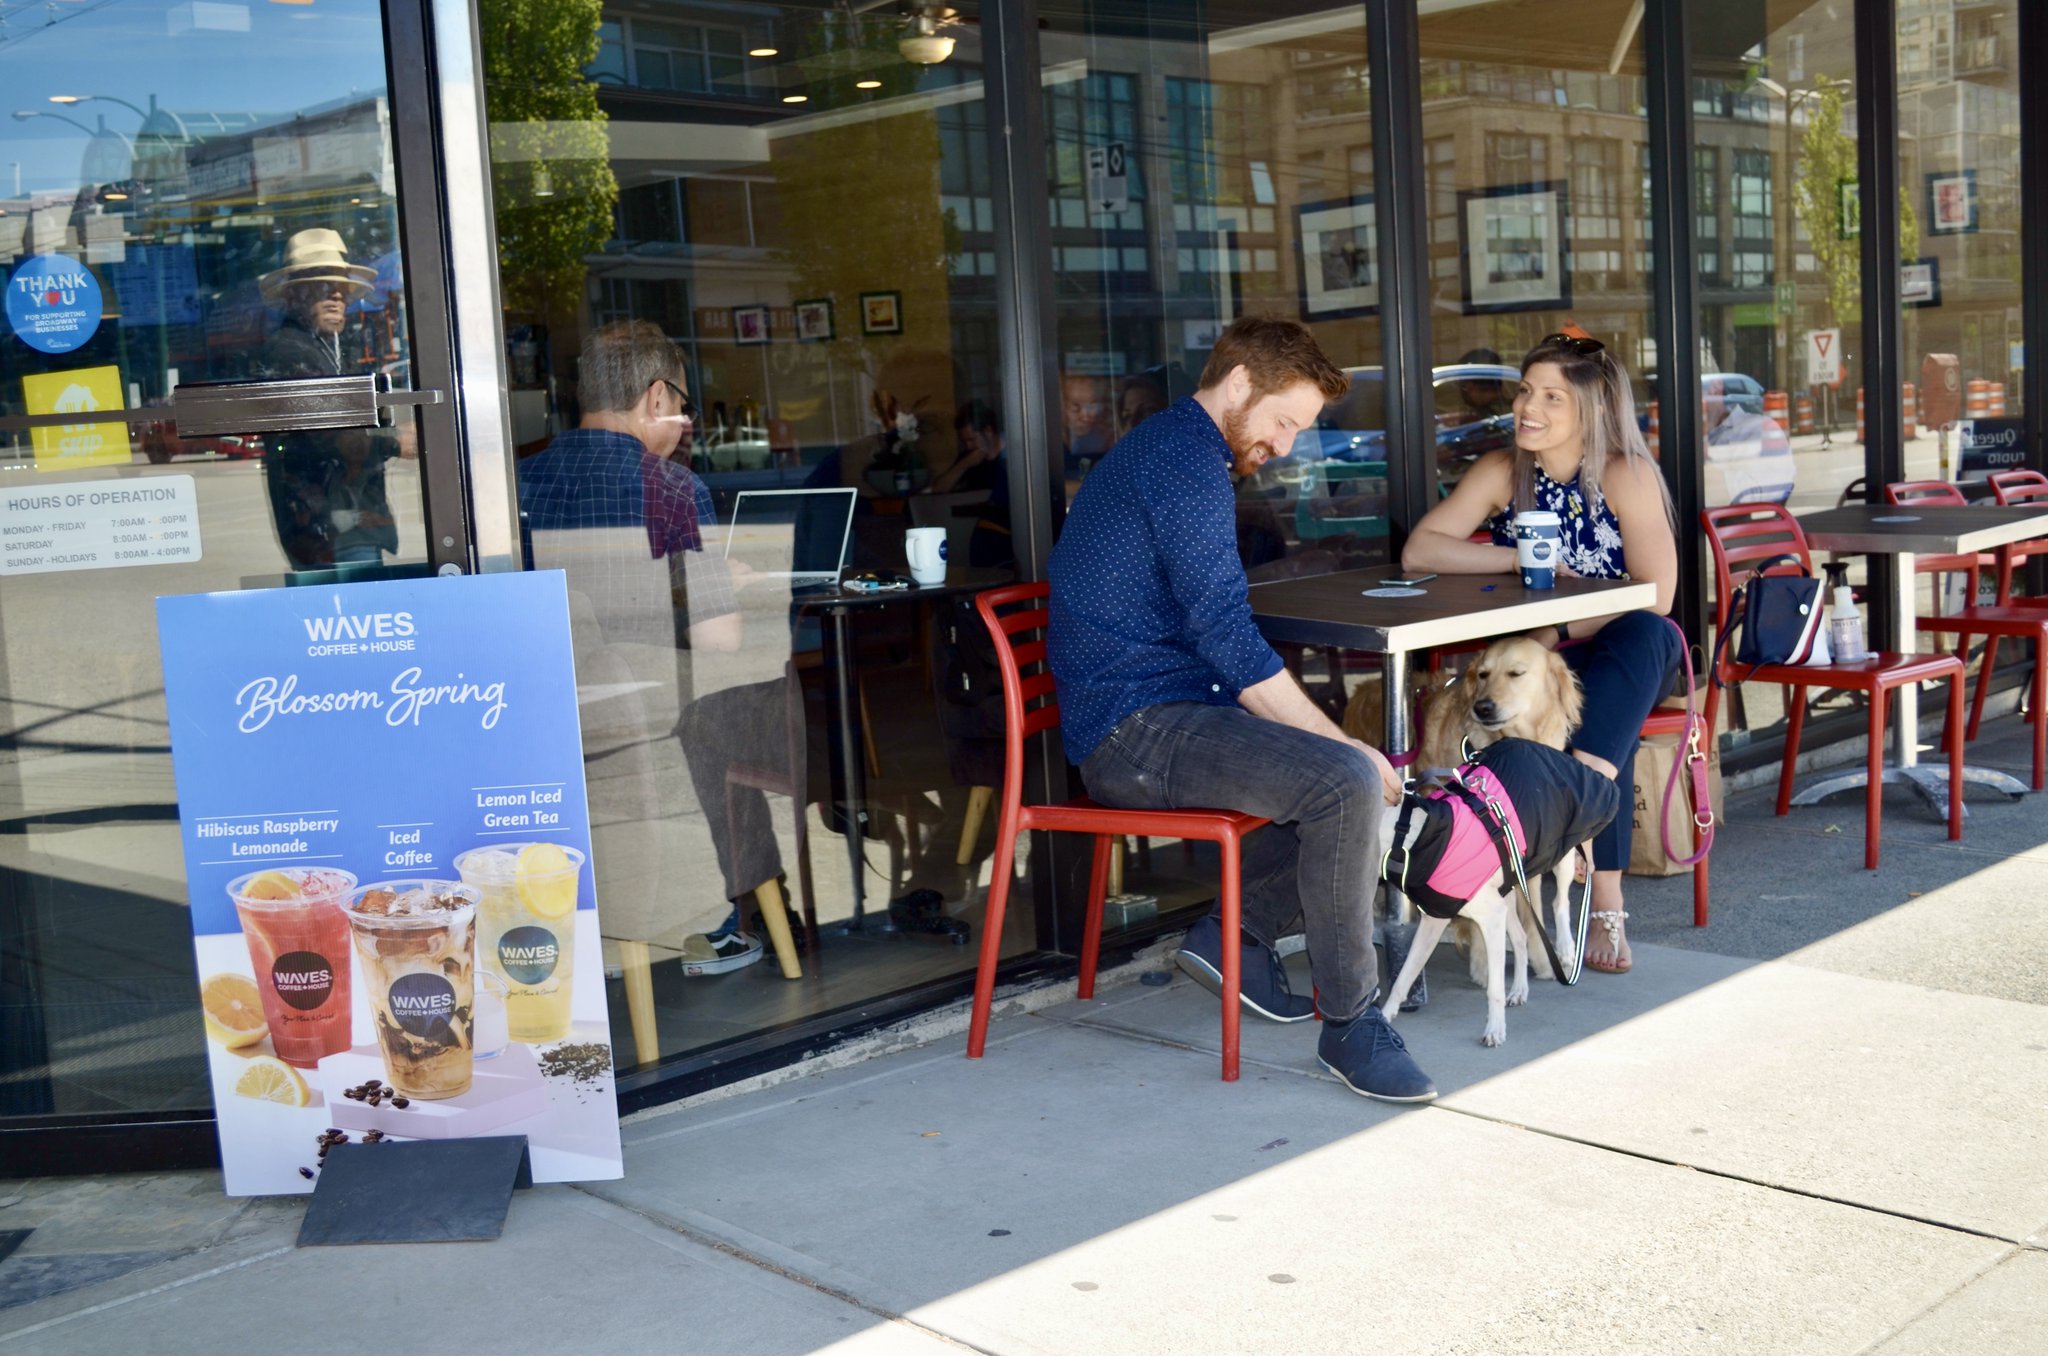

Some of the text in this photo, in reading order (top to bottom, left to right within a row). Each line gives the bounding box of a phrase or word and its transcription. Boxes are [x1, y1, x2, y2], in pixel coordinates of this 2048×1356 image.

[16, 272, 88, 293] THANK
[24, 310, 87, 321] FOR SUPPORTING
[35, 318, 77, 327] BROADWAY
[35, 324, 79, 333] BUSINESSES
[59, 434, 103, 458] SKIP
[8, 488, 176, 511] HOURS OF OPERATION
[3, 524, 44, 535] MONDAY
[52, 521, 86, 531] FRIDAY
[111, 518, 146, 527] 7:00AM
[5, 539, 54, 551] SATURDAY
[7, 556, 44, 567] SUNDAY
[51, 553, 97, 564] HOLIDAYS
[114, 549, 149, 560] 8:00AM
[157, 546, 191, 556] 4:00PM
[303, 611, 415, 642] WAVES
[307, 640, 416, 657] COFFEE HOUSE
[235, 666, 508, 734] Blossom Spring
[477, 788, 562, 808] Lemon Iced
[484, 810, 559, 827] Green Tea
[197, 817, 339, 838] Hibiscus Raspberry
[389, 829, 420, 845] Iced
[232, 838, 308, 856] Lemonade
[385, 850, 432, 866] Coffee
[501, 944, 555, 959] WAVES
[275, 969, 329, 984] WAVES
[308, 981, 330, 990] HOUSE
[392, 993, 452, 1009] WAVES
[428, 1007, 452, 1015] HOUSE
